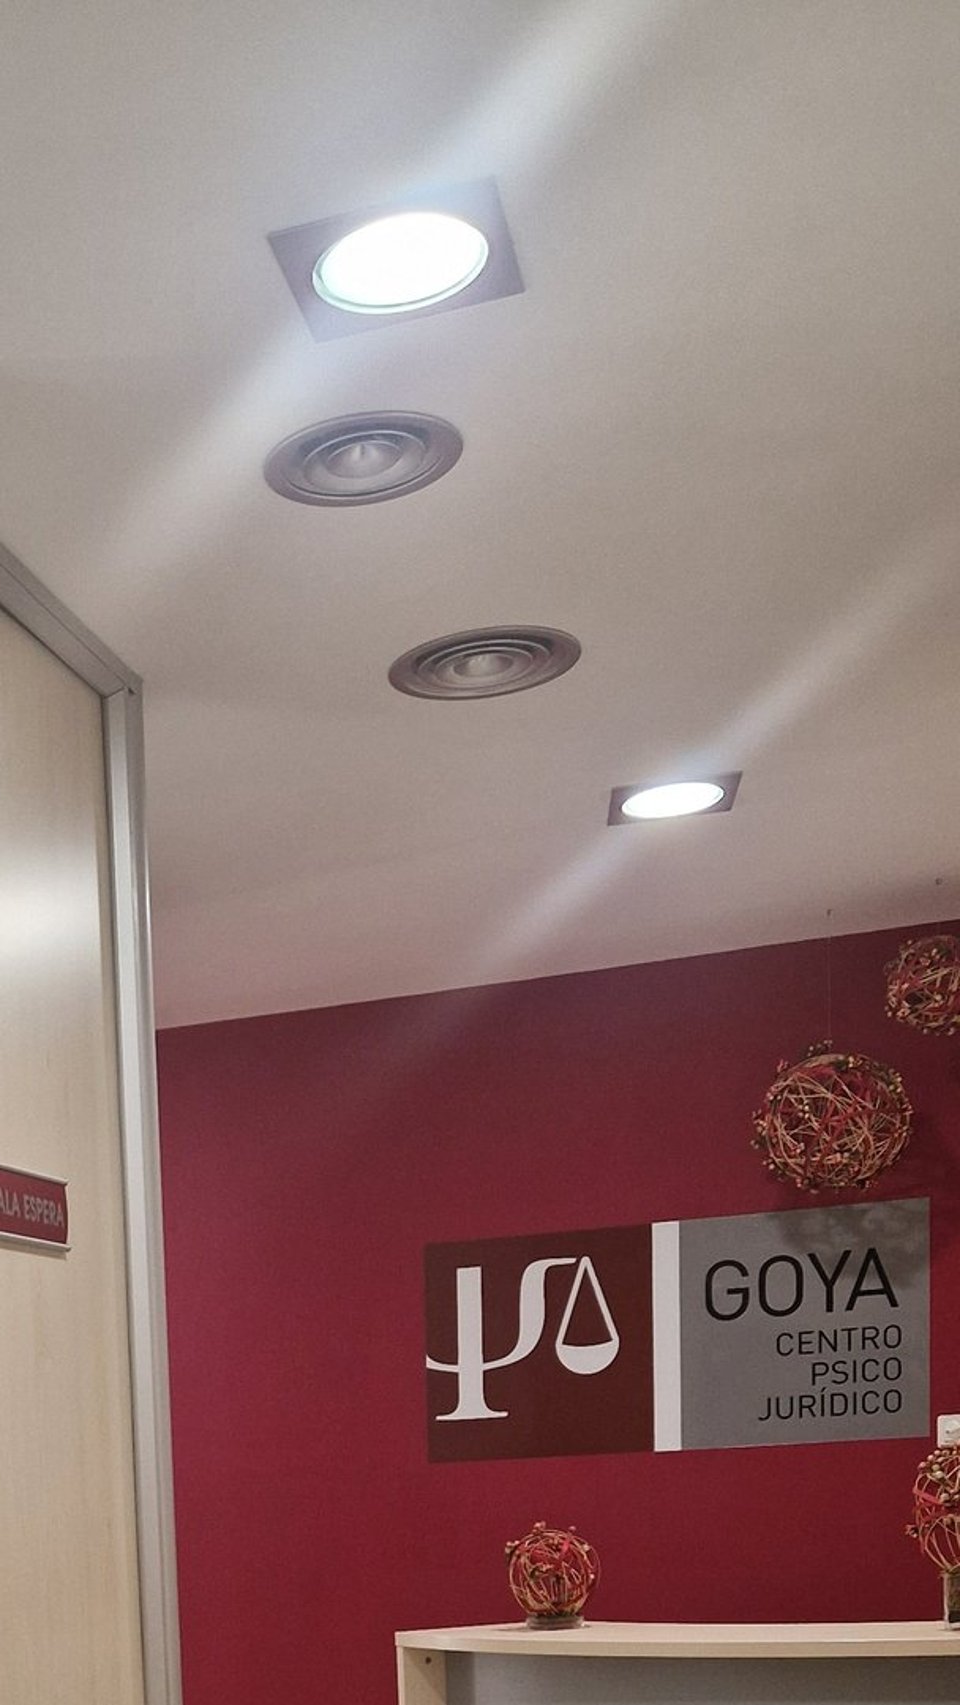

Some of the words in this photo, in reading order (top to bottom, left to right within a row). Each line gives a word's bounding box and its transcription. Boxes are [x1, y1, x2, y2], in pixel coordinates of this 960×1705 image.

[23, 1194, 65, 1228] ESPERA
[704, 1247, 899, 1321] GOYA
[776, 1324, 902, 1356] CENTRO
[811, 1357, 902, 1387] PSICO
[758, 1387, 902, 1422] JURÍDICO
